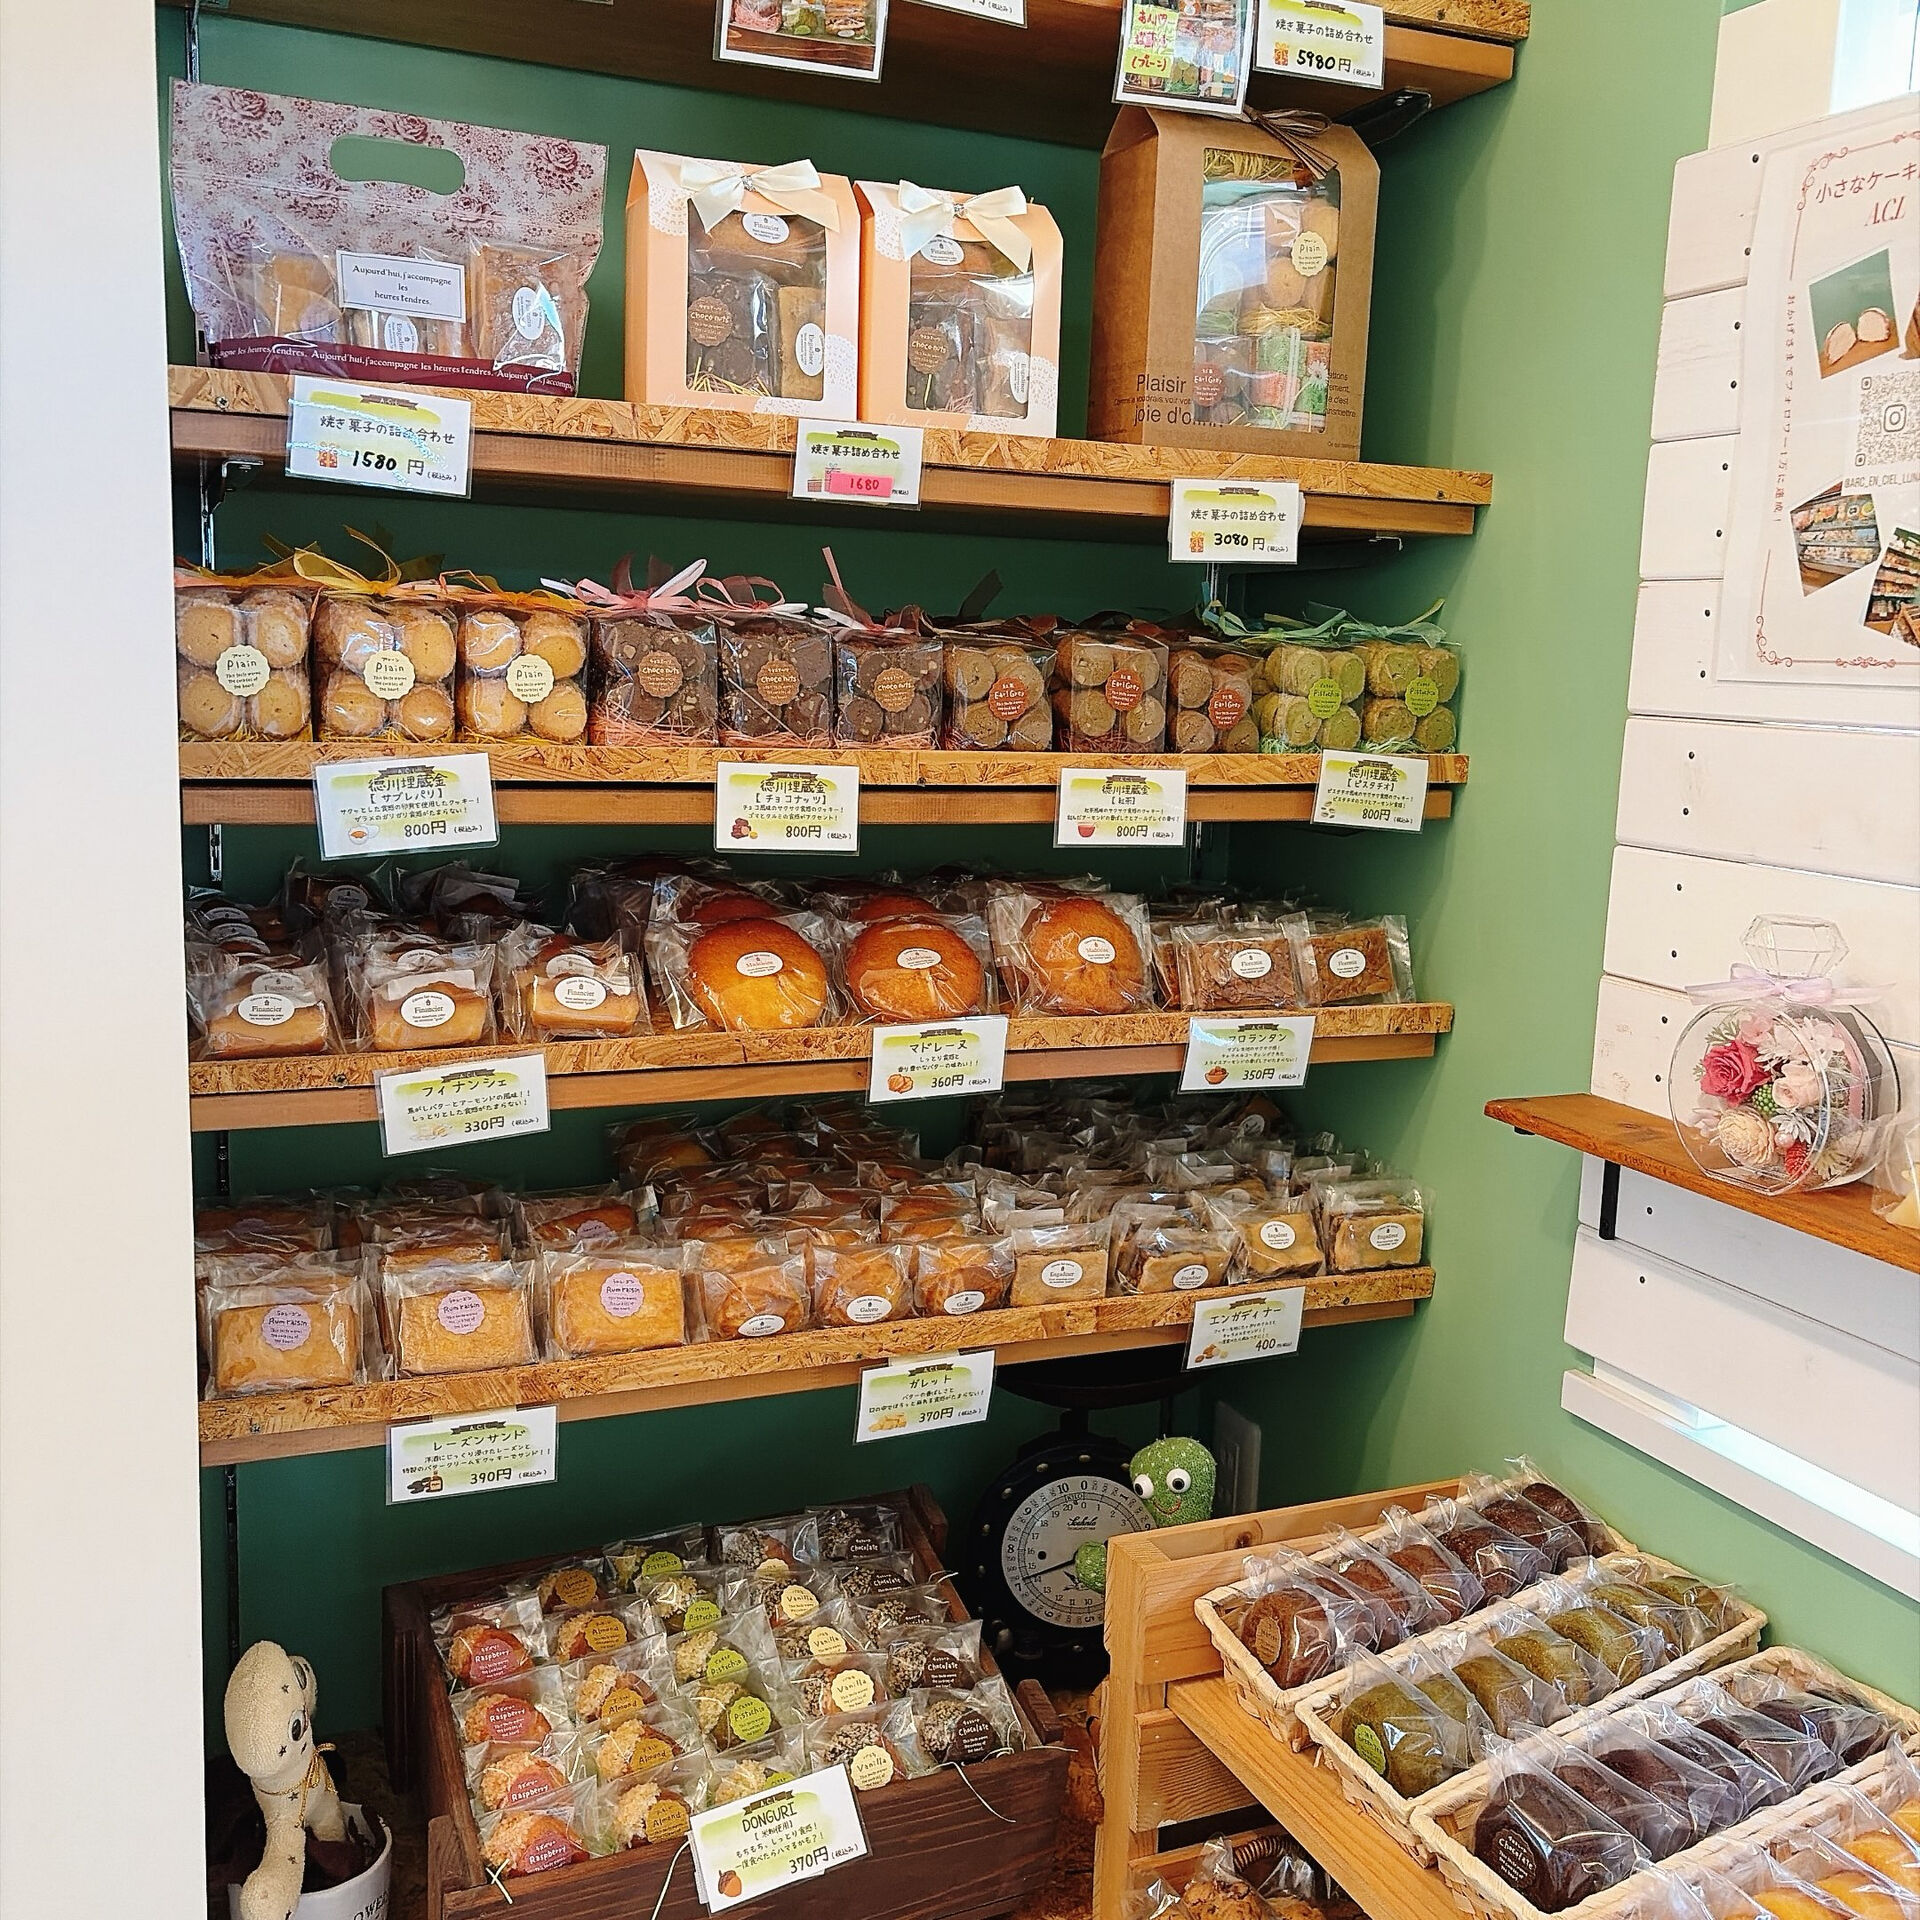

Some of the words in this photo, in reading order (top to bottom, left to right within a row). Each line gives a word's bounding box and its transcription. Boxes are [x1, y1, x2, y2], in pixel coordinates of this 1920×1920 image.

[1299, 244, 1320, 254] Plain
[1136, 373, 1187, 393] Plaisir
[1133, 404, 1161, 427] joie
[850, 478, 880, 491] 1680
[227, 659, 257, 670] Plain
[376, 662, 404, 673] Plain
[516, 669, 543, 680] Plain
[1111, 679, 1126, 688] Earl
[994, 692, 1009, 700] Earl
[1362, 808, 1390, 821] 800円
[404, 820, 446, 838] 800円
[785, 825, 821, 838] 800円
[1116, 825, 1148, 838] 800円
[252, 1005, 282, 1013] Financier
[414, 1005, 444, 1014] Financier
[1228, 1033, 1287, 1044] フロランタン
[910, 1040, 967, 1054] マドレーヌ
[931, 1074, 964, 1088] 360円
[1242, 1068, 1275, 1081] 350円
[422, 1079, 507, 1097] フィナンシェ
[464, 1116, 505, 1133] 330円
[606, 1286, 621, 1294] Rum
[443, 1306, 459, 1314] Rum
[1210, 1307, 1282, 1325] エンガディナー
[268, 1318, 285, 1326] Rum
[910, 1375, 951, 1389] ガレット
[919, 1407, 954, 1423] 370円
[433, 1429, 527, 1451] レーズンサンド
[470, 1468, 512, 1485] 390円
[814, 1637, 839, 1647] Vanilla
[475, 1649, 510, 1663] Raspberry
[928, 1662, 958, 1672] Chocolate
[836, 1679, 867, 1693] Vanilla
[609, 1700, 637, 1714] Almond
[490, 1709, 525, 1722] Raspberry
[958, 1724, 989, 1736] Chocolate
[639, 1752, 666, 1764] Almond
[856, 1758, 887, 1772] Vanilla
[511, 1784, 549, 1802] Raspberry
[653, 1811, 681, 1828] Almond
[742, 1802, 797, 1832] DONGURI
[529, 1845, 566, 1864] Raspberry
[788, 1846, 829, 1874] 370円
[1498, 1838, 1534, 1870] Chocolate
